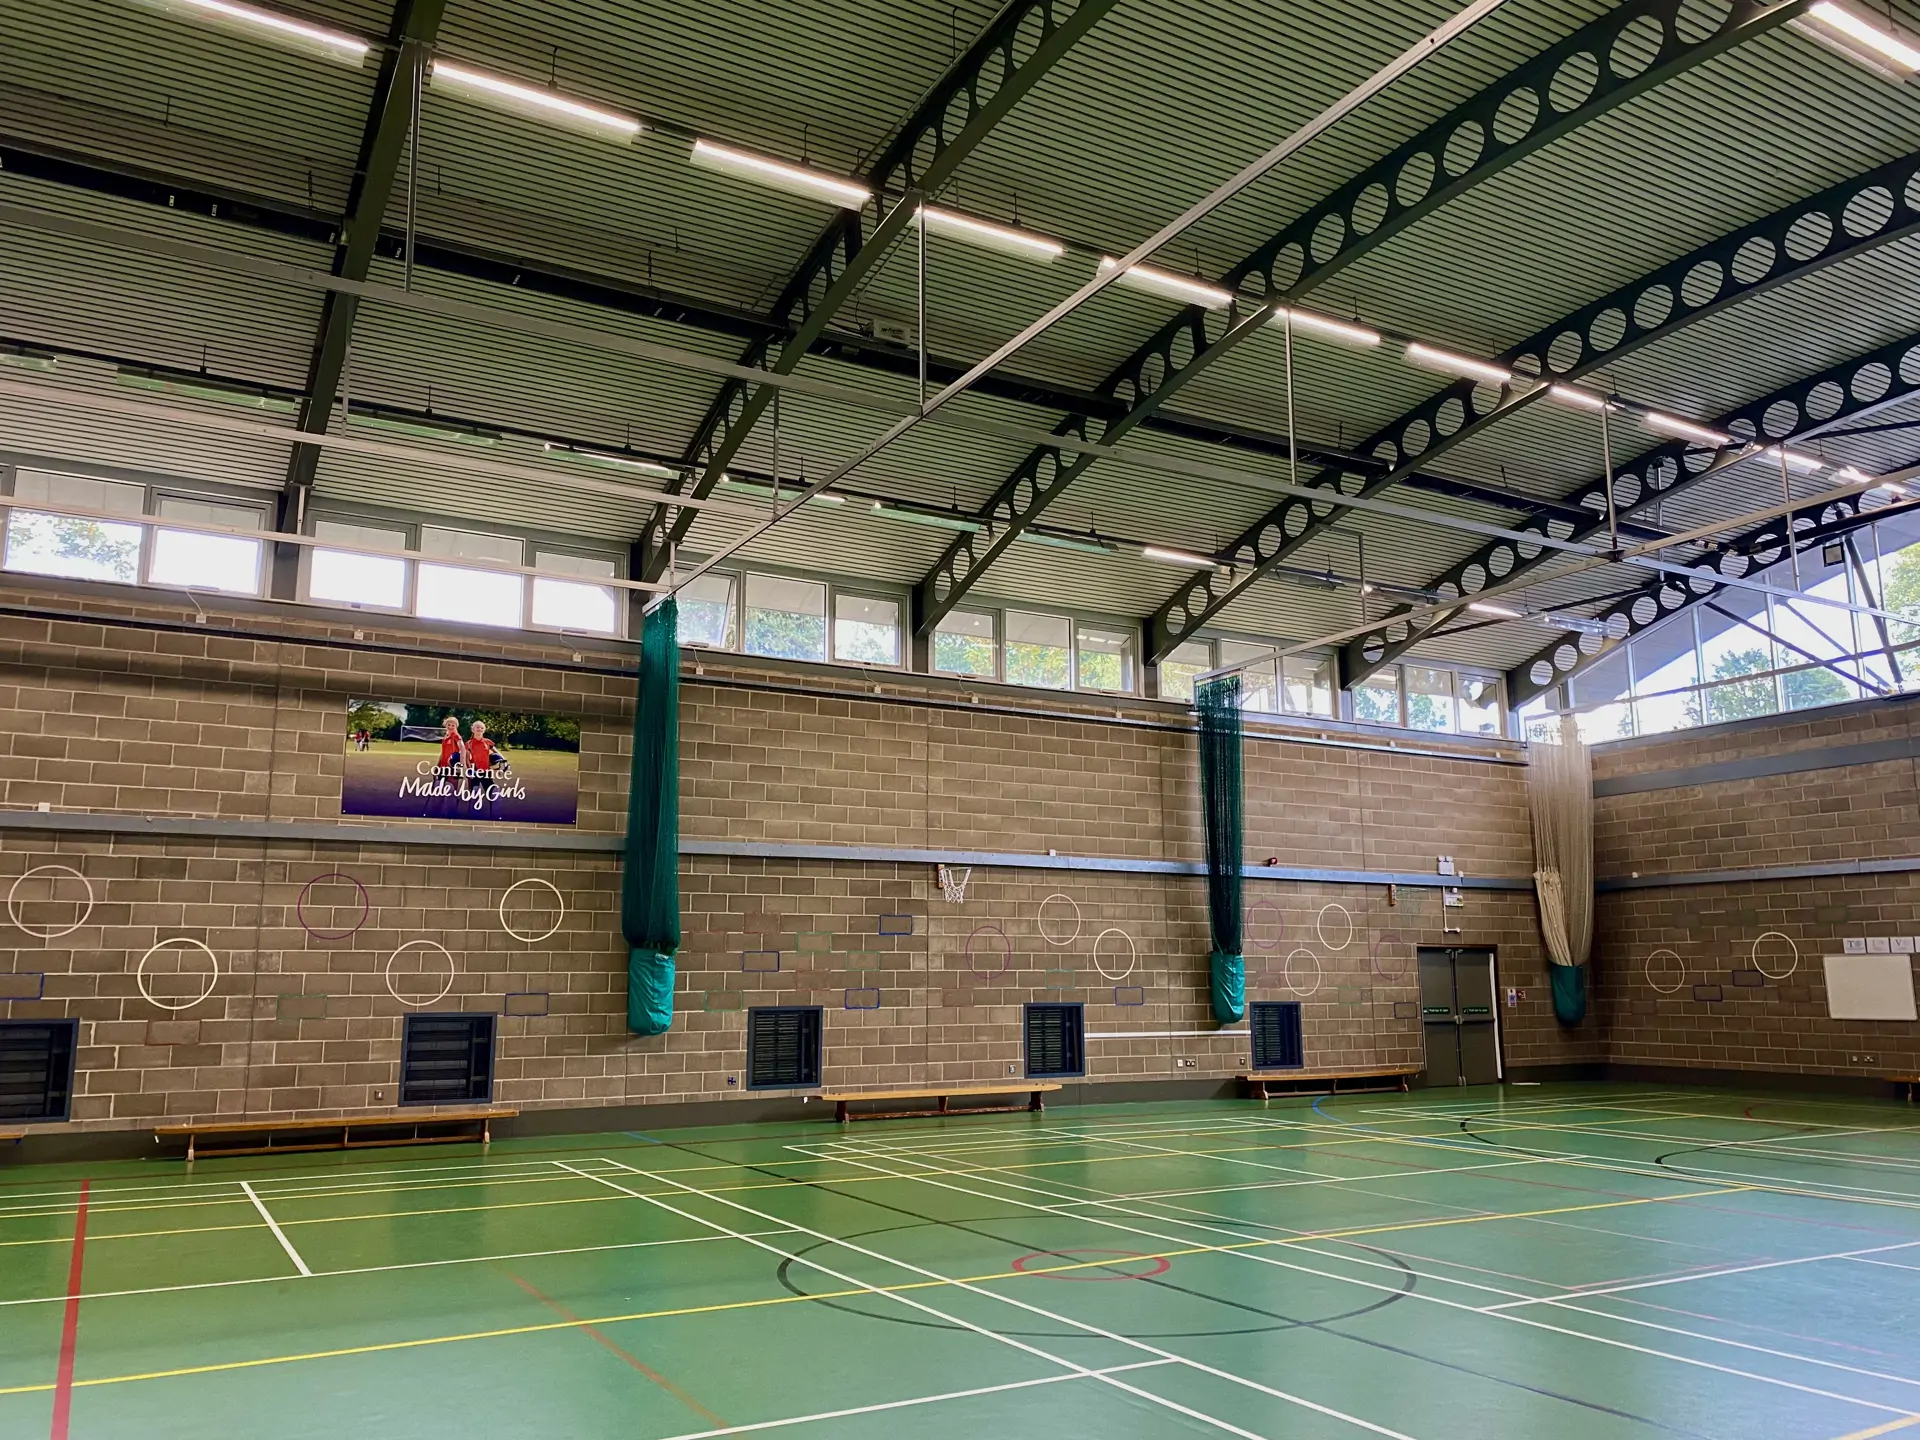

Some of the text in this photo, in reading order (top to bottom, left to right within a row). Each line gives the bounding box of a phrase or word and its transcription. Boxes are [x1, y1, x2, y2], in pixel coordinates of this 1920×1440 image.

[416, 760, 513, 780] Confidence
[399, 776, 526, 810] Made by Girls
